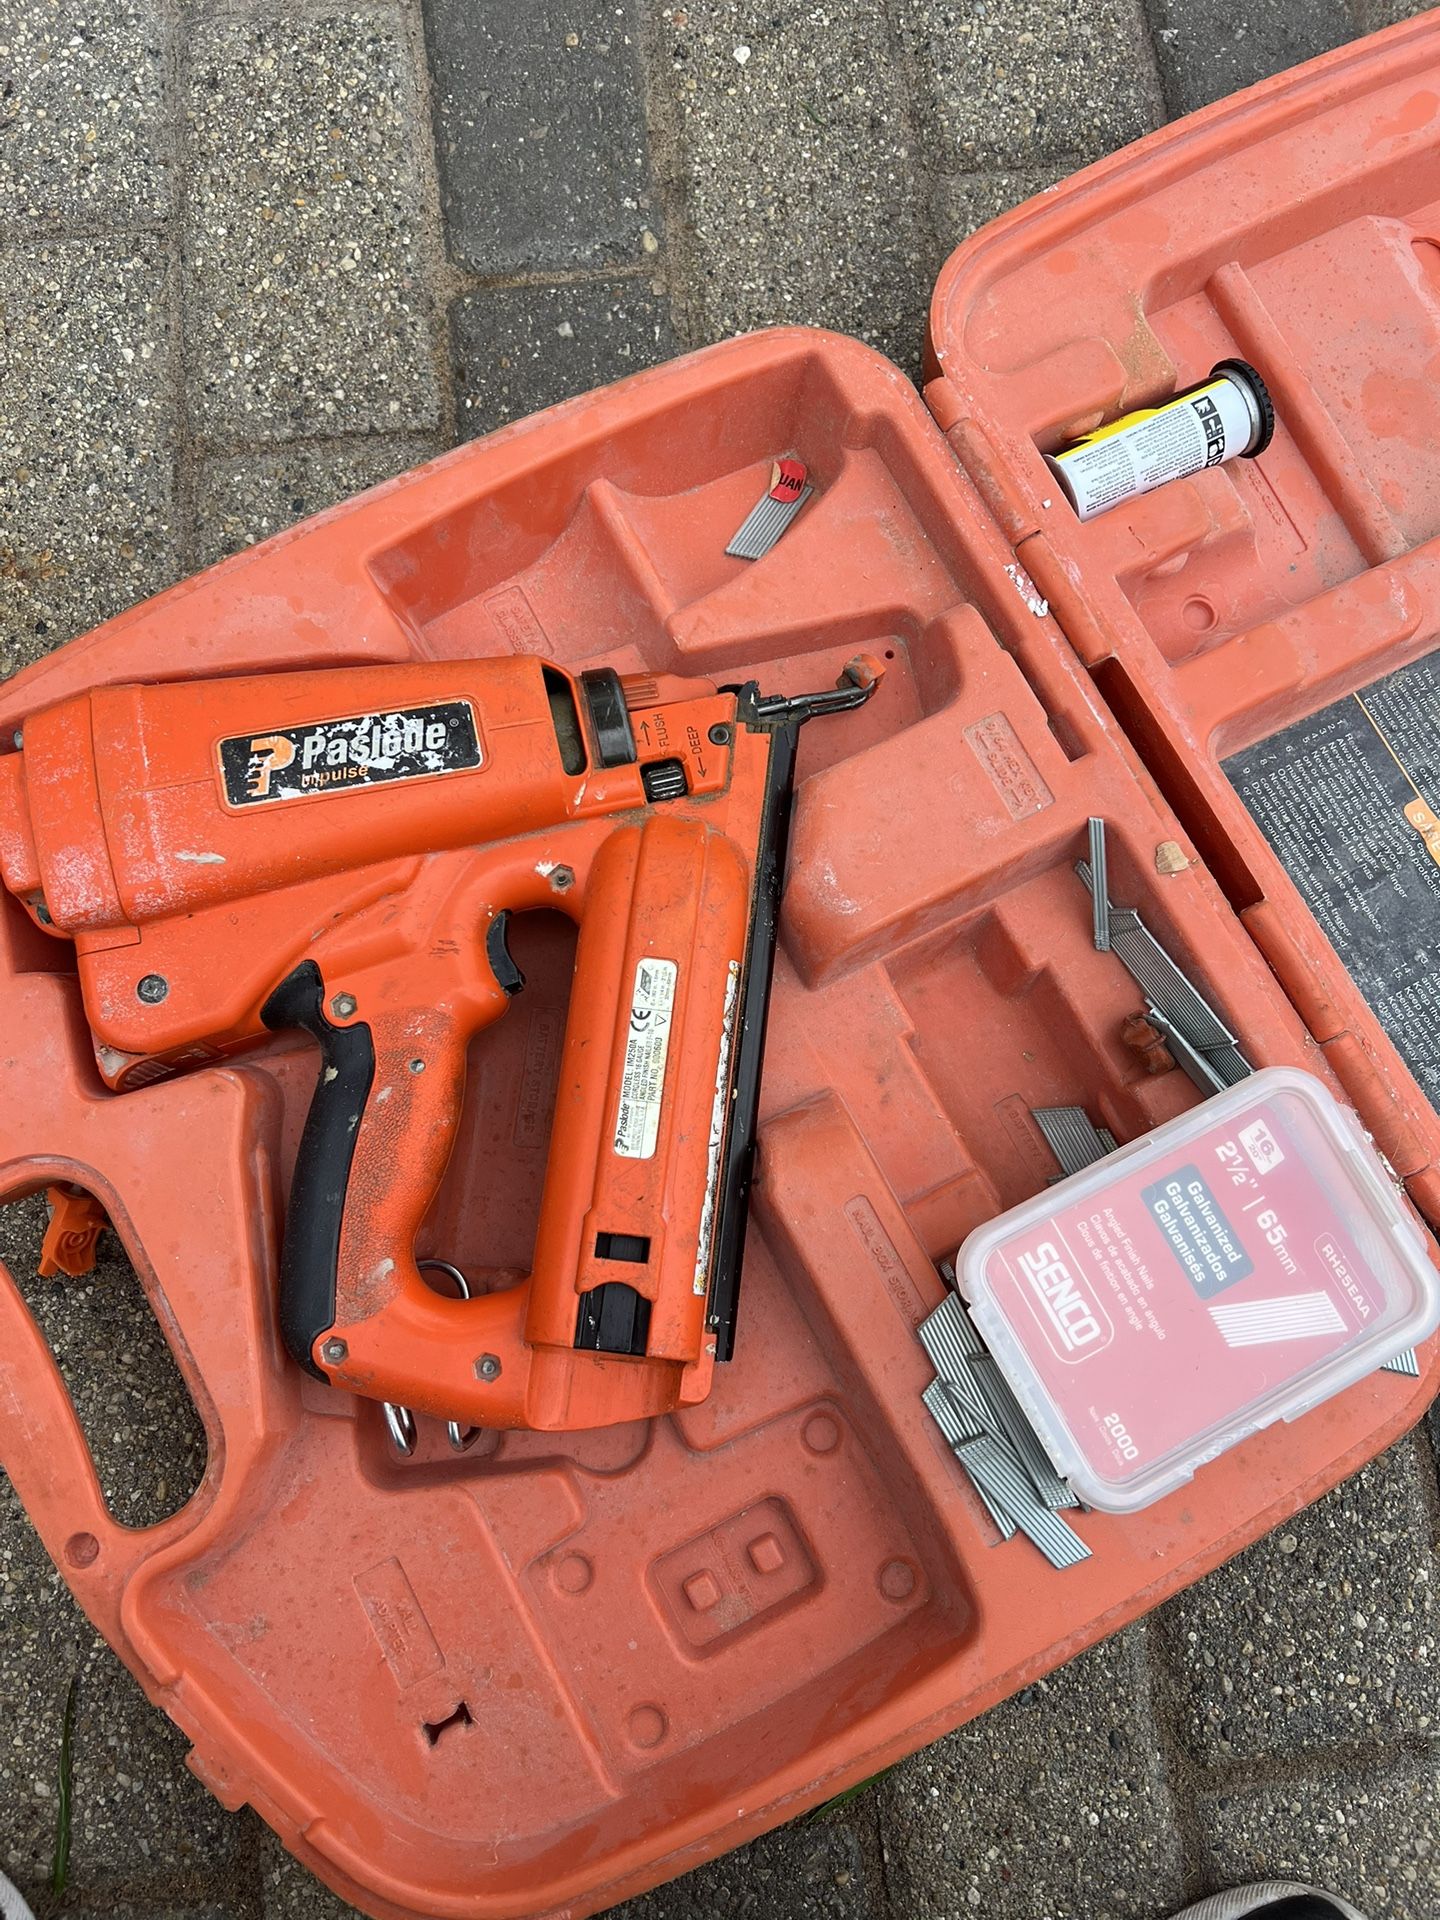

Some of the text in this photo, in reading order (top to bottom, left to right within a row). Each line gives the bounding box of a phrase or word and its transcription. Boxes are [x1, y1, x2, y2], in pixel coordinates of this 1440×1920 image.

[1405, 677, 1431, 712] or in the
[1413, 672, 1428, 690] may
[1422, 667, 1435, 685] The
[298, 713, 449, 771] Paslode
[653, 713, 669, 746] FLUSH
[687, 726, 702, 753] DEEP
[1364, 697, 1421, 783] Exposure to carbon
[1372, 693, 1398, 730] because
[1397, 732, 1408, 746] the
[1408, 748, 1422, 766] tool
[1380, 690, 1438, 776] releasing flammable
[1387, 684, 1439, 760] being exposed to
[1423, 722, 1432, 731] or
[985, 750, 1011, 788] SLIDE
[1260, 778, 1291, 823] contacting
[1303, 755, 1313, 767] on
[1311, 768, 1319, 777] or
[1317, 779, 1349, 826] depressing
[1347, 826, 1360, 841] the
[1320, 746, 1338, 771] Never
[1335, 773, 1354, 795] point
[1351, 796, 1362, 810] the
[1360, 811, 1375, 829] tool
[1372, 830, 1381, 839] at
[1328, 741, 1346, 766] Never
[1344, 768, 1368, 801] assume
[1366, 802, 1381, 820] tool
[1336, 738, 1358, 768] Always
[1356, 769, 1372, 789] wear
[1370, 791, 1383, 807] eye
[1380, 808, 1395, 825] and
[1392, 825, 1416, 857] hearing
[1345, 733, 1440, 878] Read tool manual carefully cover to
[1243, 786, 1252, 796] or
[1250, 797, 1266, 819] work
[1264, 820, 1295, 866] contacting
[1293, 866, 1318, 901] element
[1269, 772, 1359, 913] Never disable or remove the work
[1278, 768, 1301, 803] Operate
[1299, 804, 1311, 818] the
[1309, 819, 1325, 837] tool
[1320, 838, 1335, 856] only
[1333, 858, 1343, 870] on
[1341, 870, 1354, 883] the
[1294, 759, 1313, 784] Never
[1311, 786, 1334, 820] operate
[1337, 827, 1351, 845] tool
[1348, 845, 1362, 863] that
[1360, 863, 1374, 880] has
[1311, 750, 1408, 898] Never carry the tool with your finger
[1251, 781, 1352, 936] Do not load fasteners with the trigger
[1387, 995, 1405, 1020] Keep
[1395, 990, 1415, 1018] being
[1404, 986, 1436, 1031] Keep your
[1413, 981, 1431, 1006] Keep
[1421, 977, 1436, 994] and
[1376, 998, 1434, 1084] charger away from
[618, 1103, 629, 1137] Paslode
[647, 1081, 656, 1100] PART
[1250, 1126, 1276, 1158] 16
[1103, 1208, 1154, 1290] Angled Finish Nails
[1154, 1199, 1205, 1282] Galvanisés
[1166, 1182, 1227, 1281] Galvanizados
[1187, 1181, 1242, 1263] Galvanized
[1257, 1209, 1297, 1275] 65mm
[1024, 1242, 1100, 1346] SENCO
[1077, 1221, 1143, 1331] Clous de finition en angle
[1090, 1214, 1111, 1244] Clavos
[1107, 1245, 1118, 1257] de
[1114, 1258, 1140, 1296] acabado
[1137, 1297, 1148, 1309] en
[1322, 1244, 1370, 1318] RH25EAA
[887, 1273, 923, 1328] STORAG
[1104, 1413, 1138, 1460] 2000
